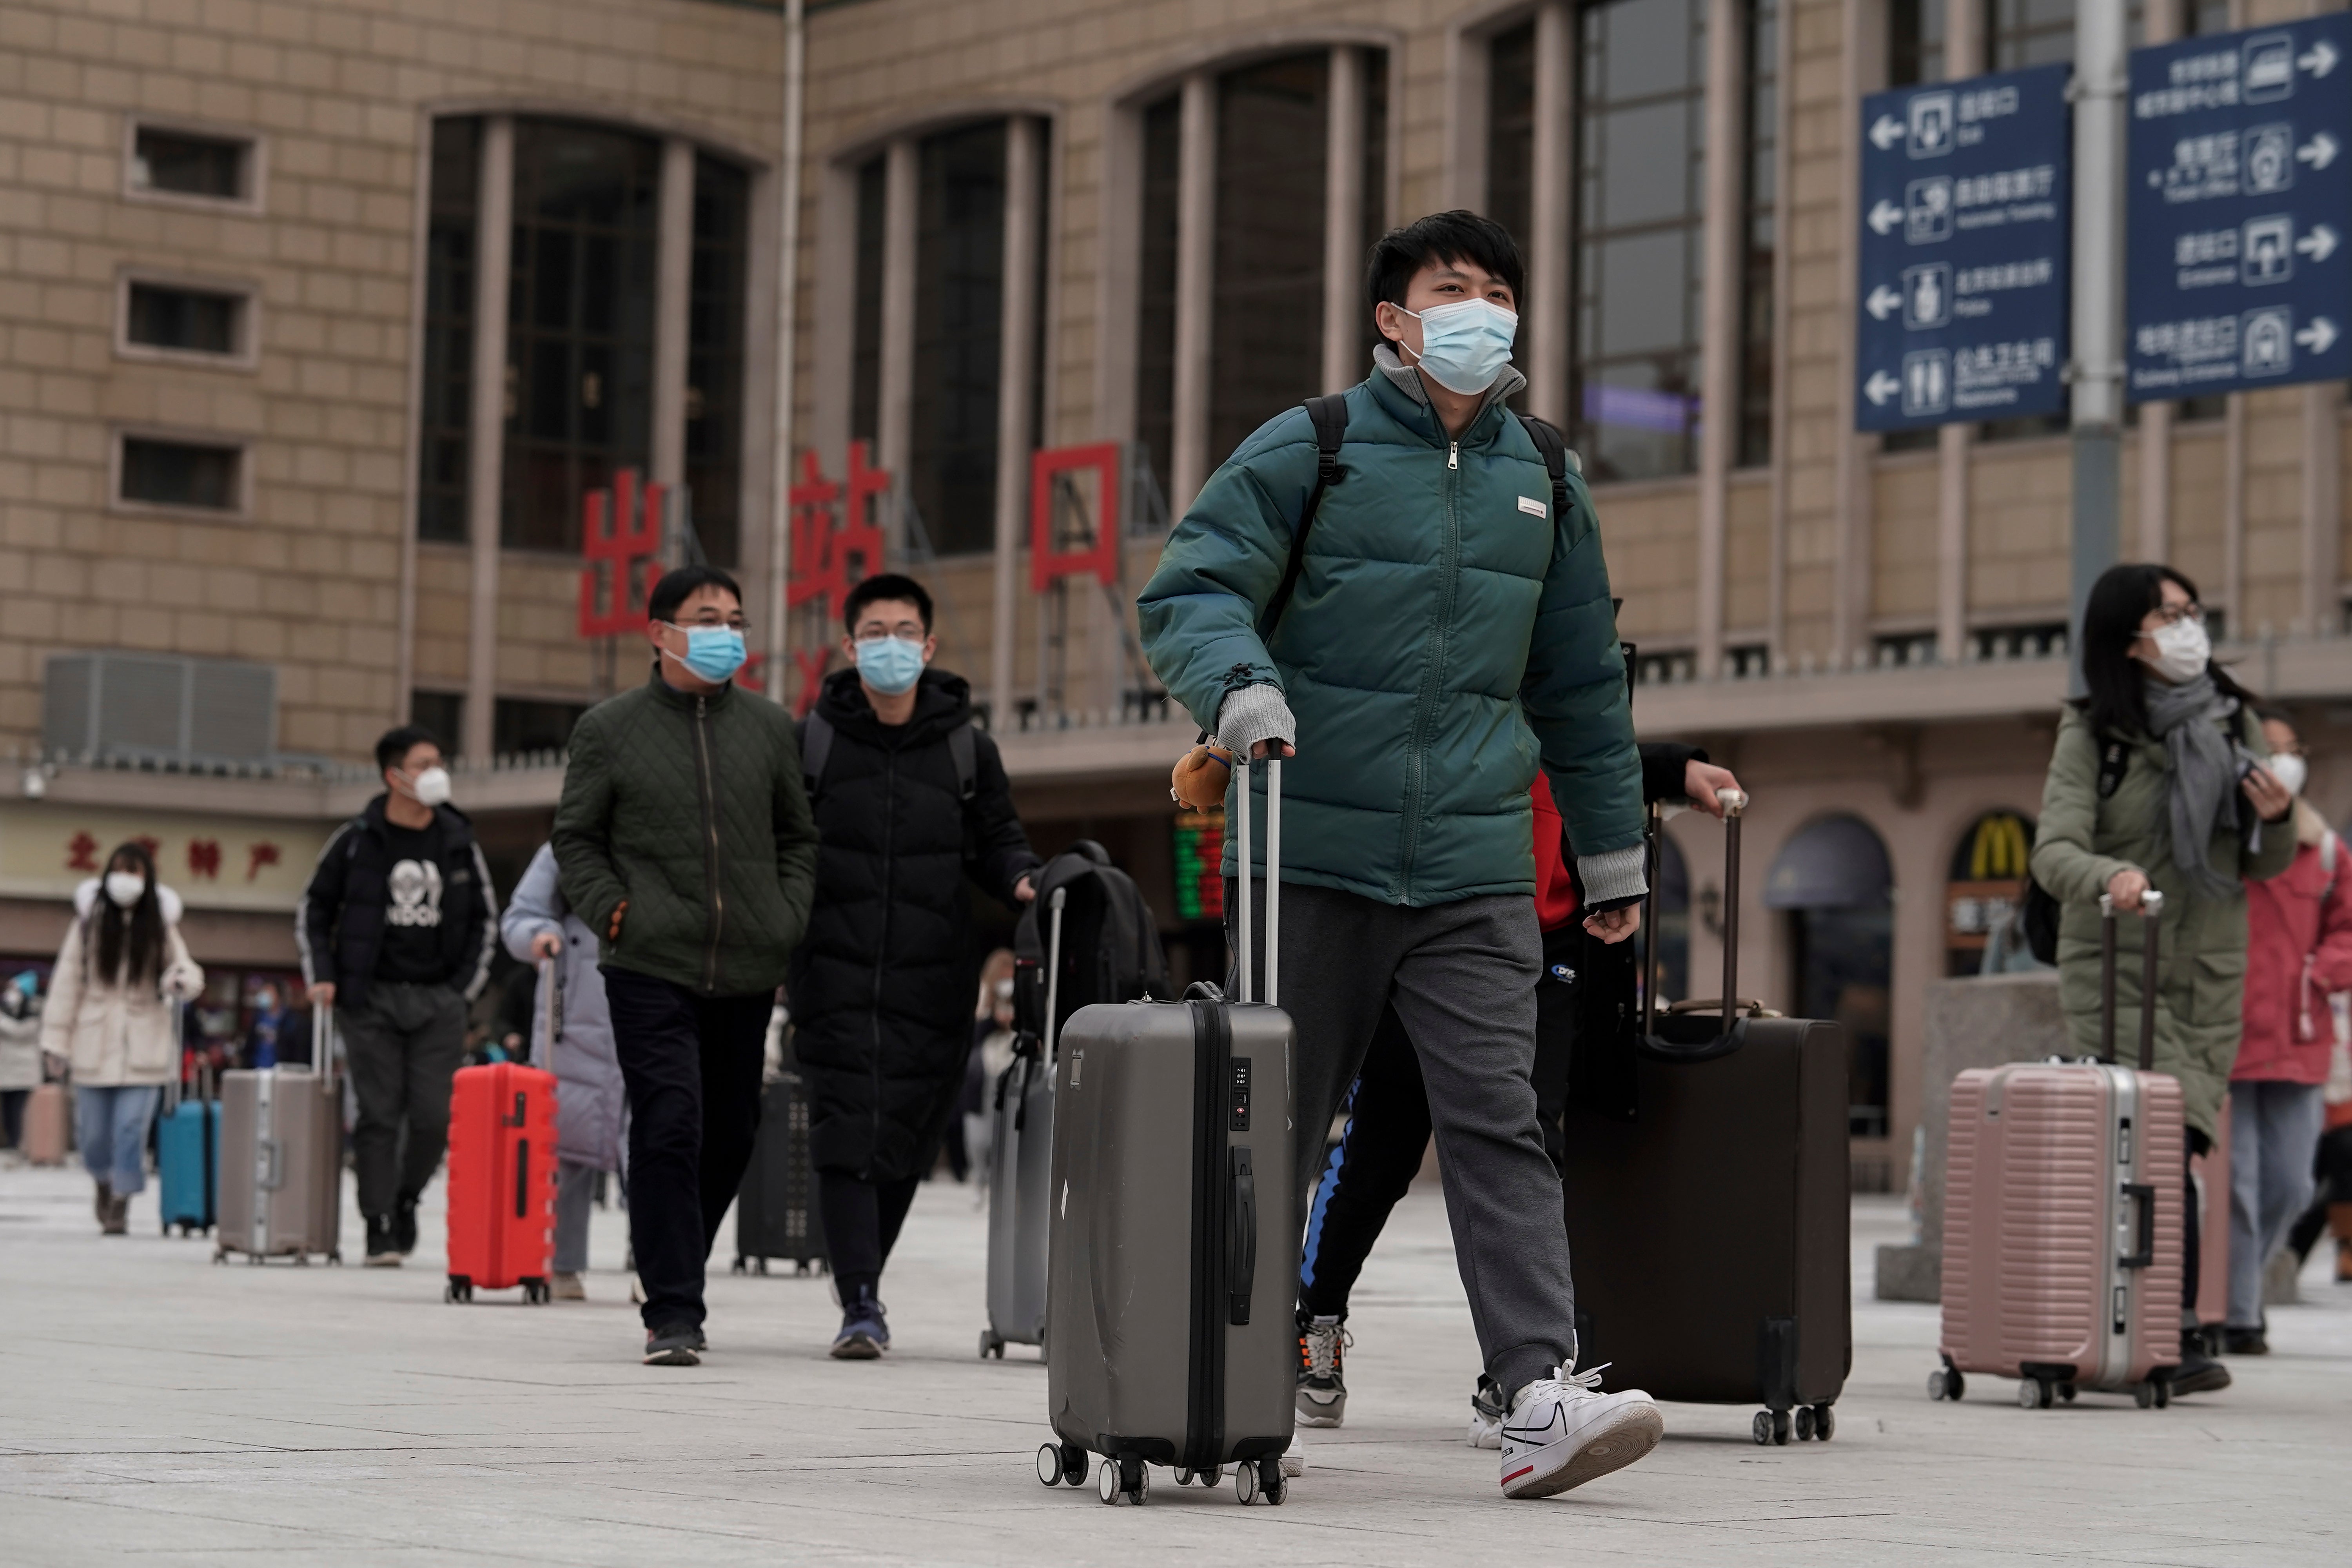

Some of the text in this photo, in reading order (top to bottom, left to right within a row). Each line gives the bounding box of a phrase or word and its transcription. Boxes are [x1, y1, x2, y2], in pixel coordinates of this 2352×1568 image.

[580, 441, 1119, 637] 出站口
[66, 830, 281, 884] 北特产
